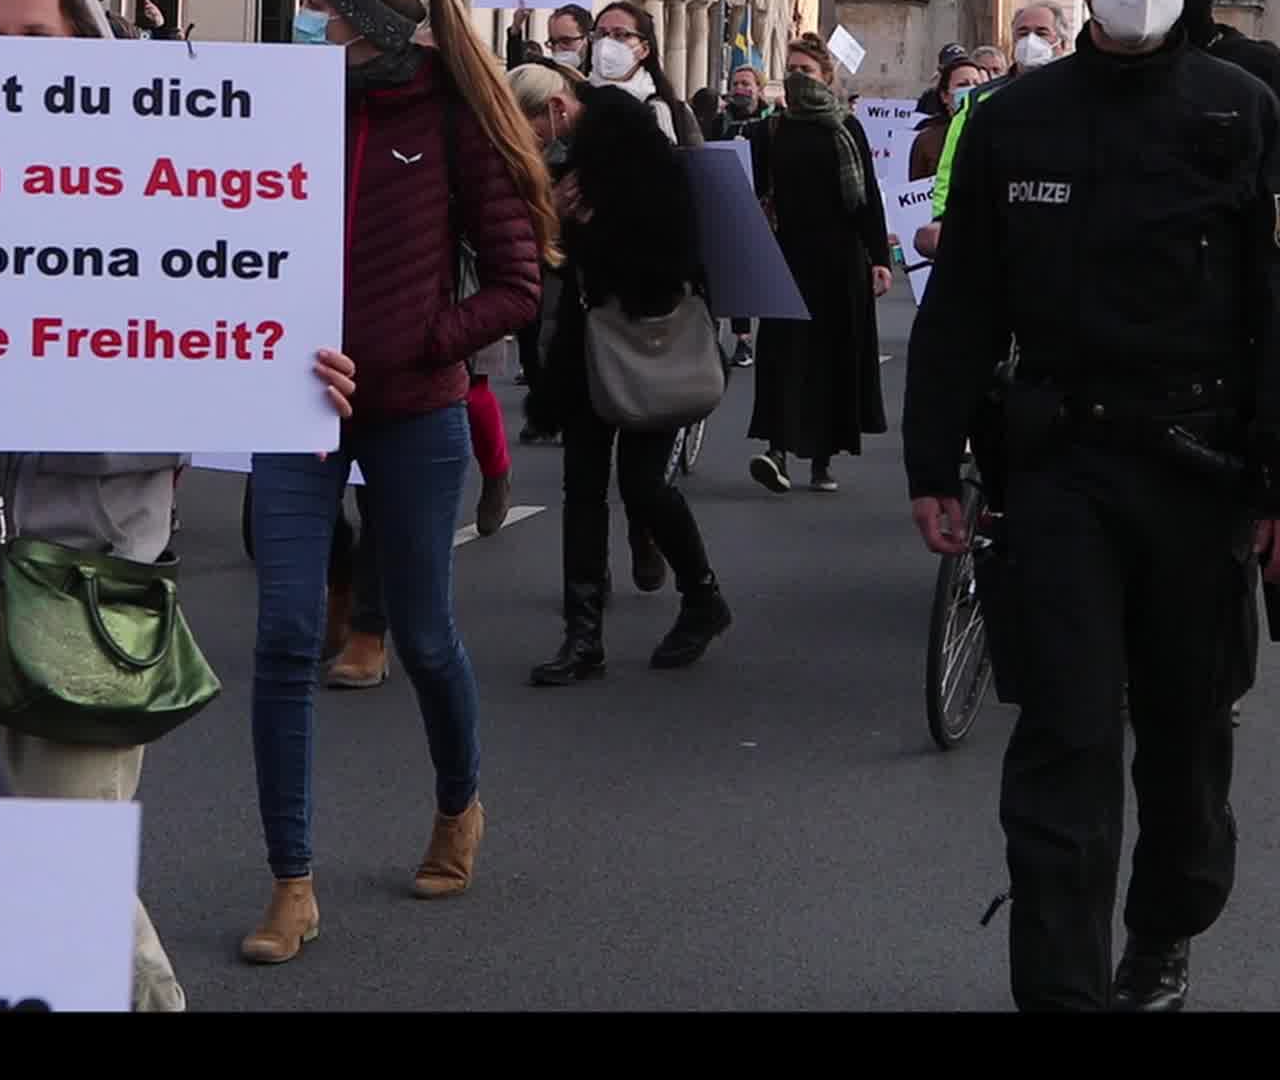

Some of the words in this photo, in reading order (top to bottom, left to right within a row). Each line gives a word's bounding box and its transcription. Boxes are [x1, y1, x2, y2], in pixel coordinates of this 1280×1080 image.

[43, 77, 111, 115] du
[132, 79, 252, 118] dich
[22, 162, 123, 196] aus
[143, 157, 308, 209] Angst
[1008, 181, 1071, 203] POLIZEI
[160, 240, 288, 279] oder
[31, 318, 285, 360] Freiheit?
